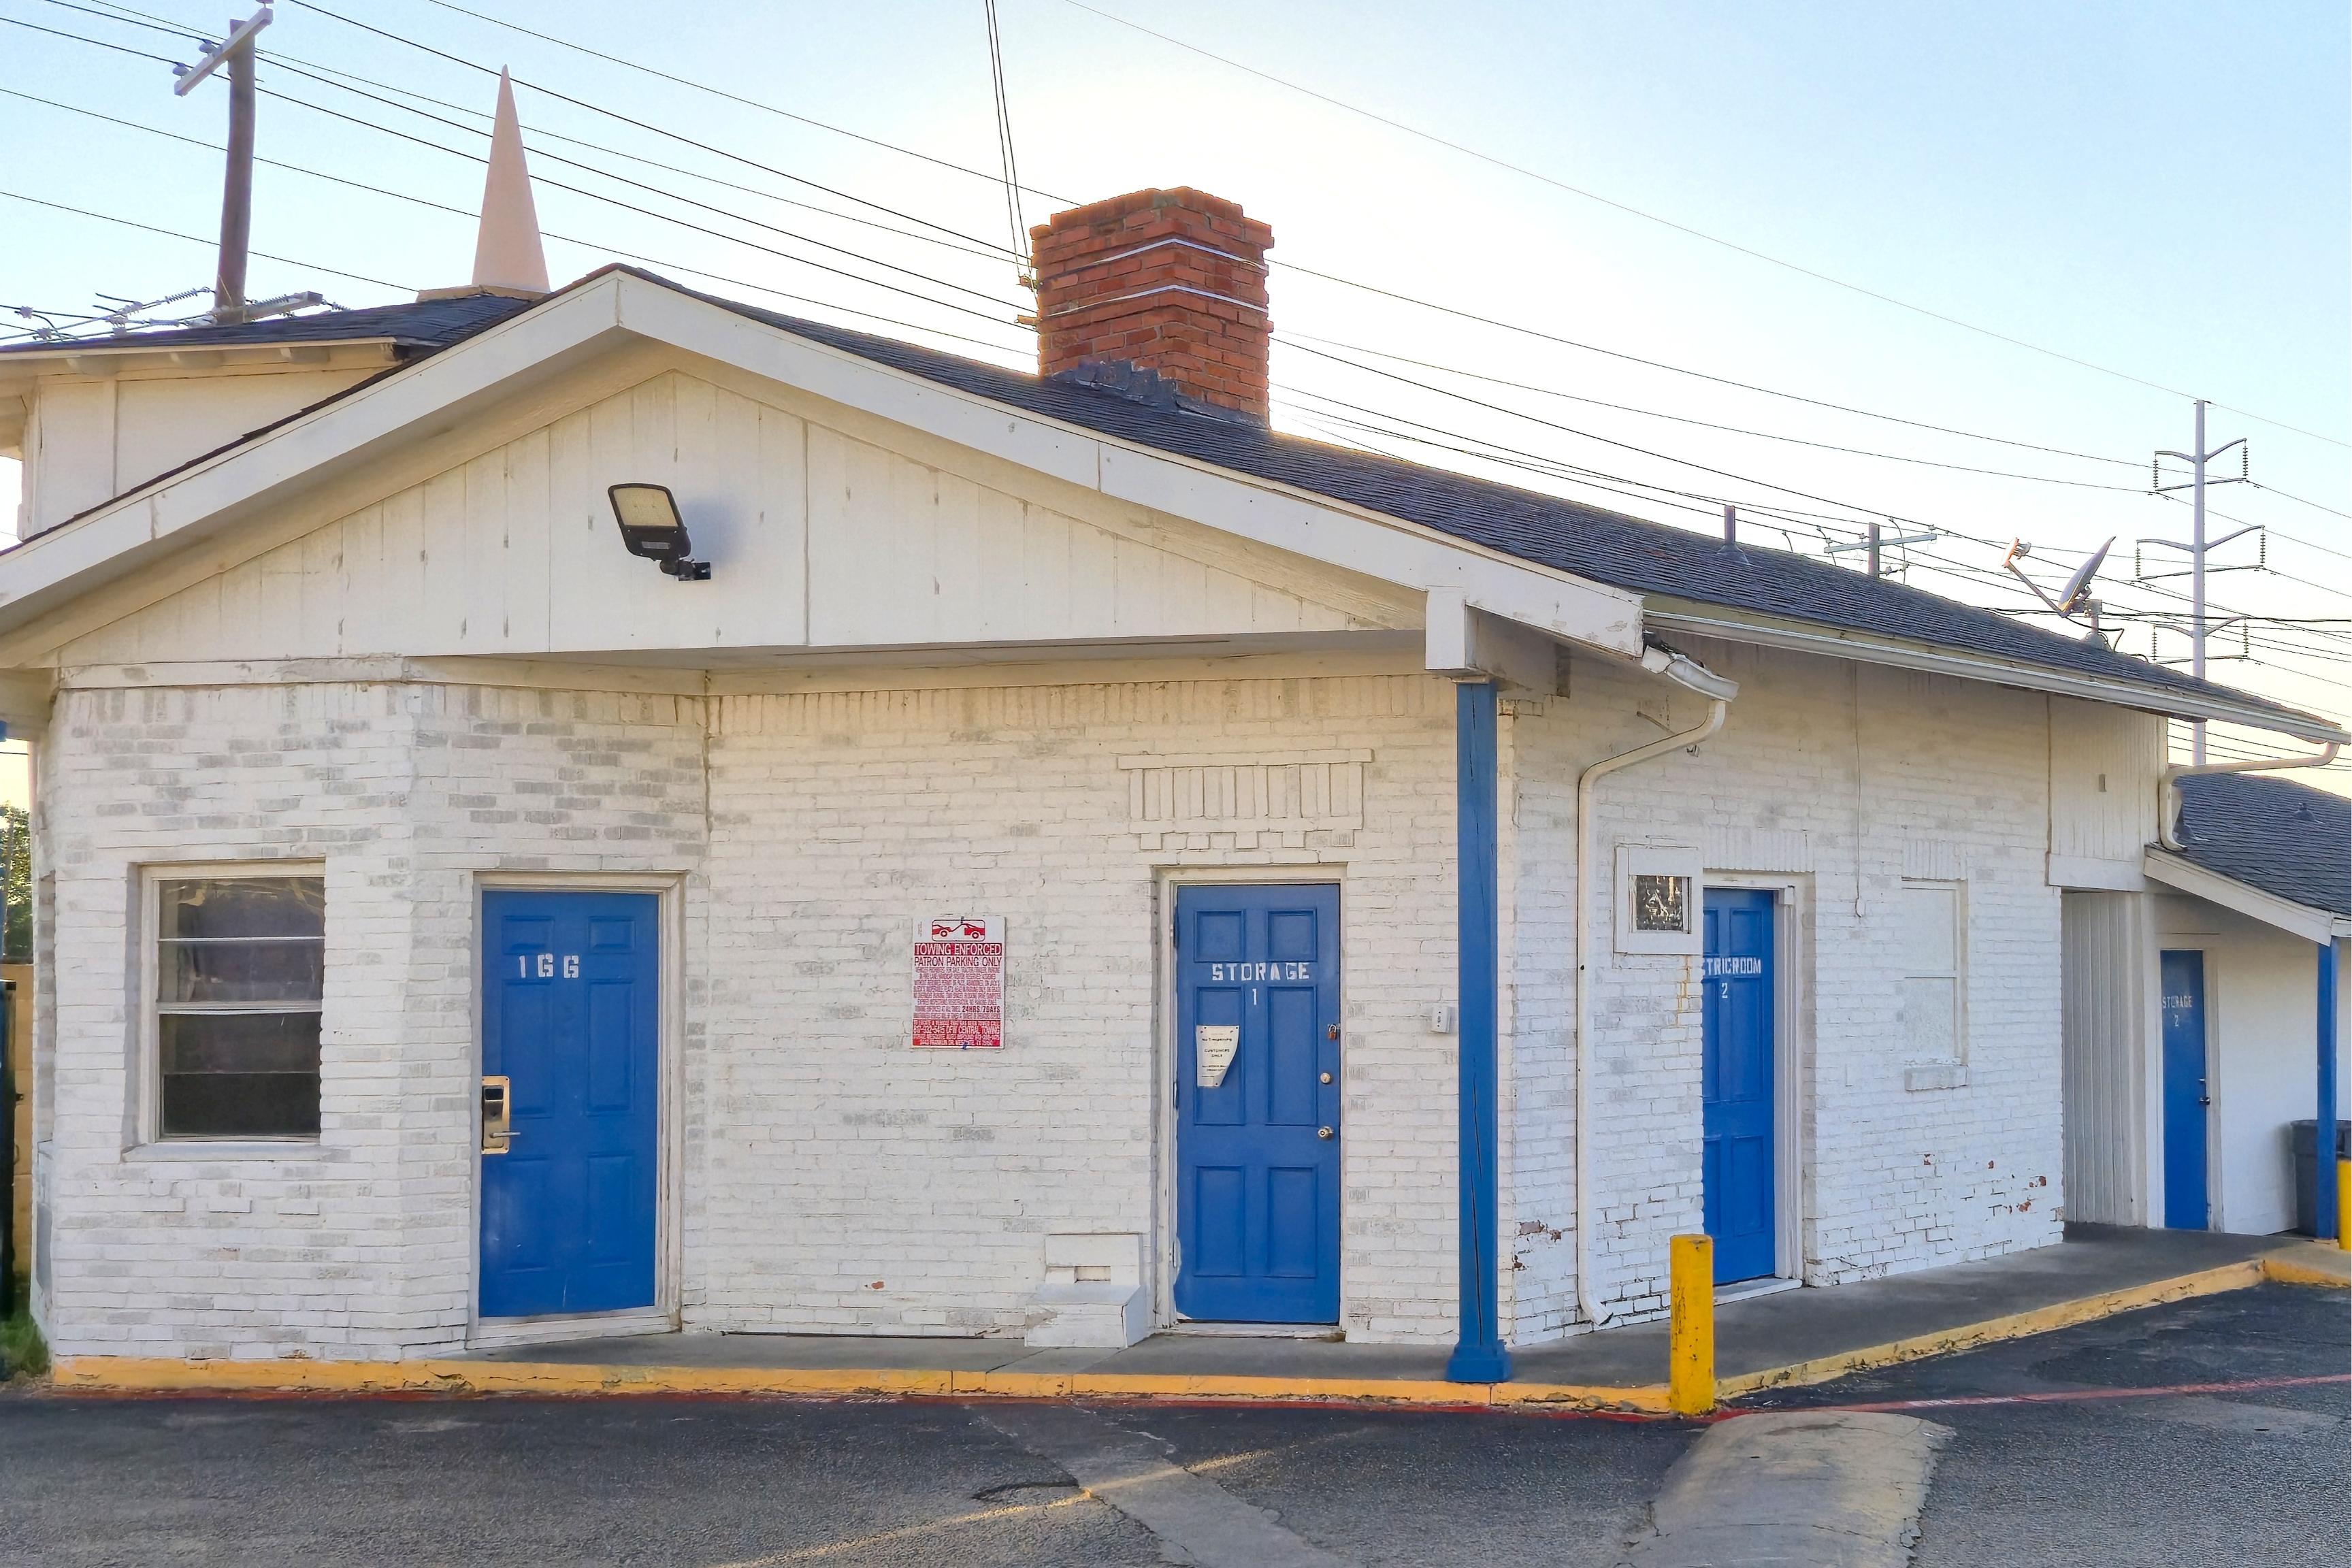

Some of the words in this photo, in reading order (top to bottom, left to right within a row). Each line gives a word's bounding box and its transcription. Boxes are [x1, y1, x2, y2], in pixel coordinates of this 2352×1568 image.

[915, 943, 951, 956] TOWING
[954, 943, 1002, 956] ENFORCED
[914, 956, 944, 967] PATRON
[946, 956, 979, 967] PARKING
[981, 956, 1002, 967] ONLY
[1211, 962, 1310, 981] STORAGE
[1252, 988, 1258, 1006] 1
[1721, 982, 1729, 999] 2
[2162, 995, 2193, 1009] STORAGE
[2174, 1014, 2180, 1027] 2
[959, 1026, 980, 1034] CENTRAL
[981, 1026, 1000, 1034] TOWING
